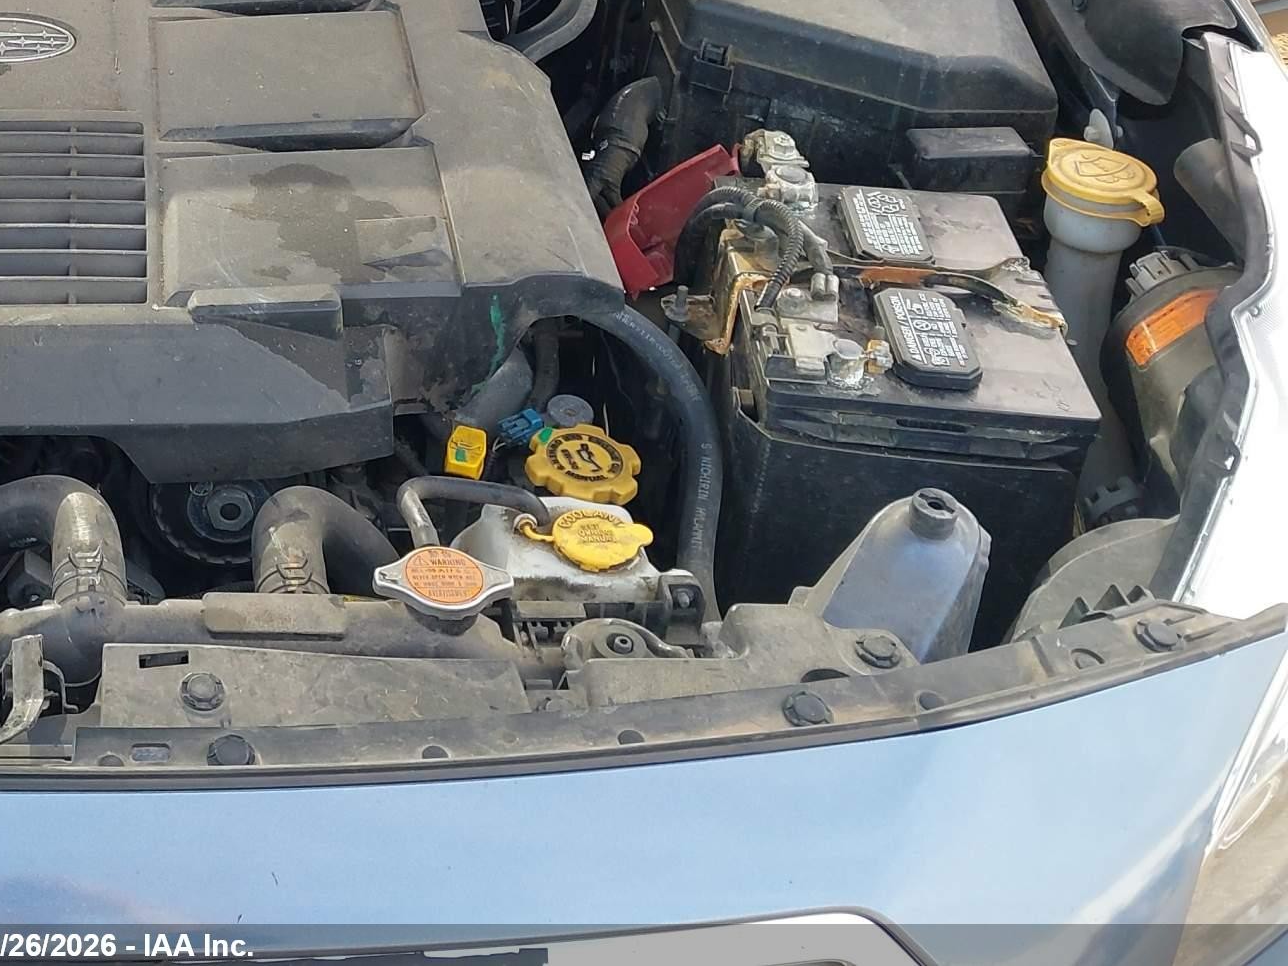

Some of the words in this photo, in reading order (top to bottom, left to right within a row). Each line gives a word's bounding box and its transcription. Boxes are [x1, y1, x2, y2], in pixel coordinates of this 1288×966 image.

[889, 295, 907, 321] POISON
[698, 456, 712, 501] NICHIRIN
[557, 509, 626, 529] COOLANT
[430, 558, 467, 566] WARNING
